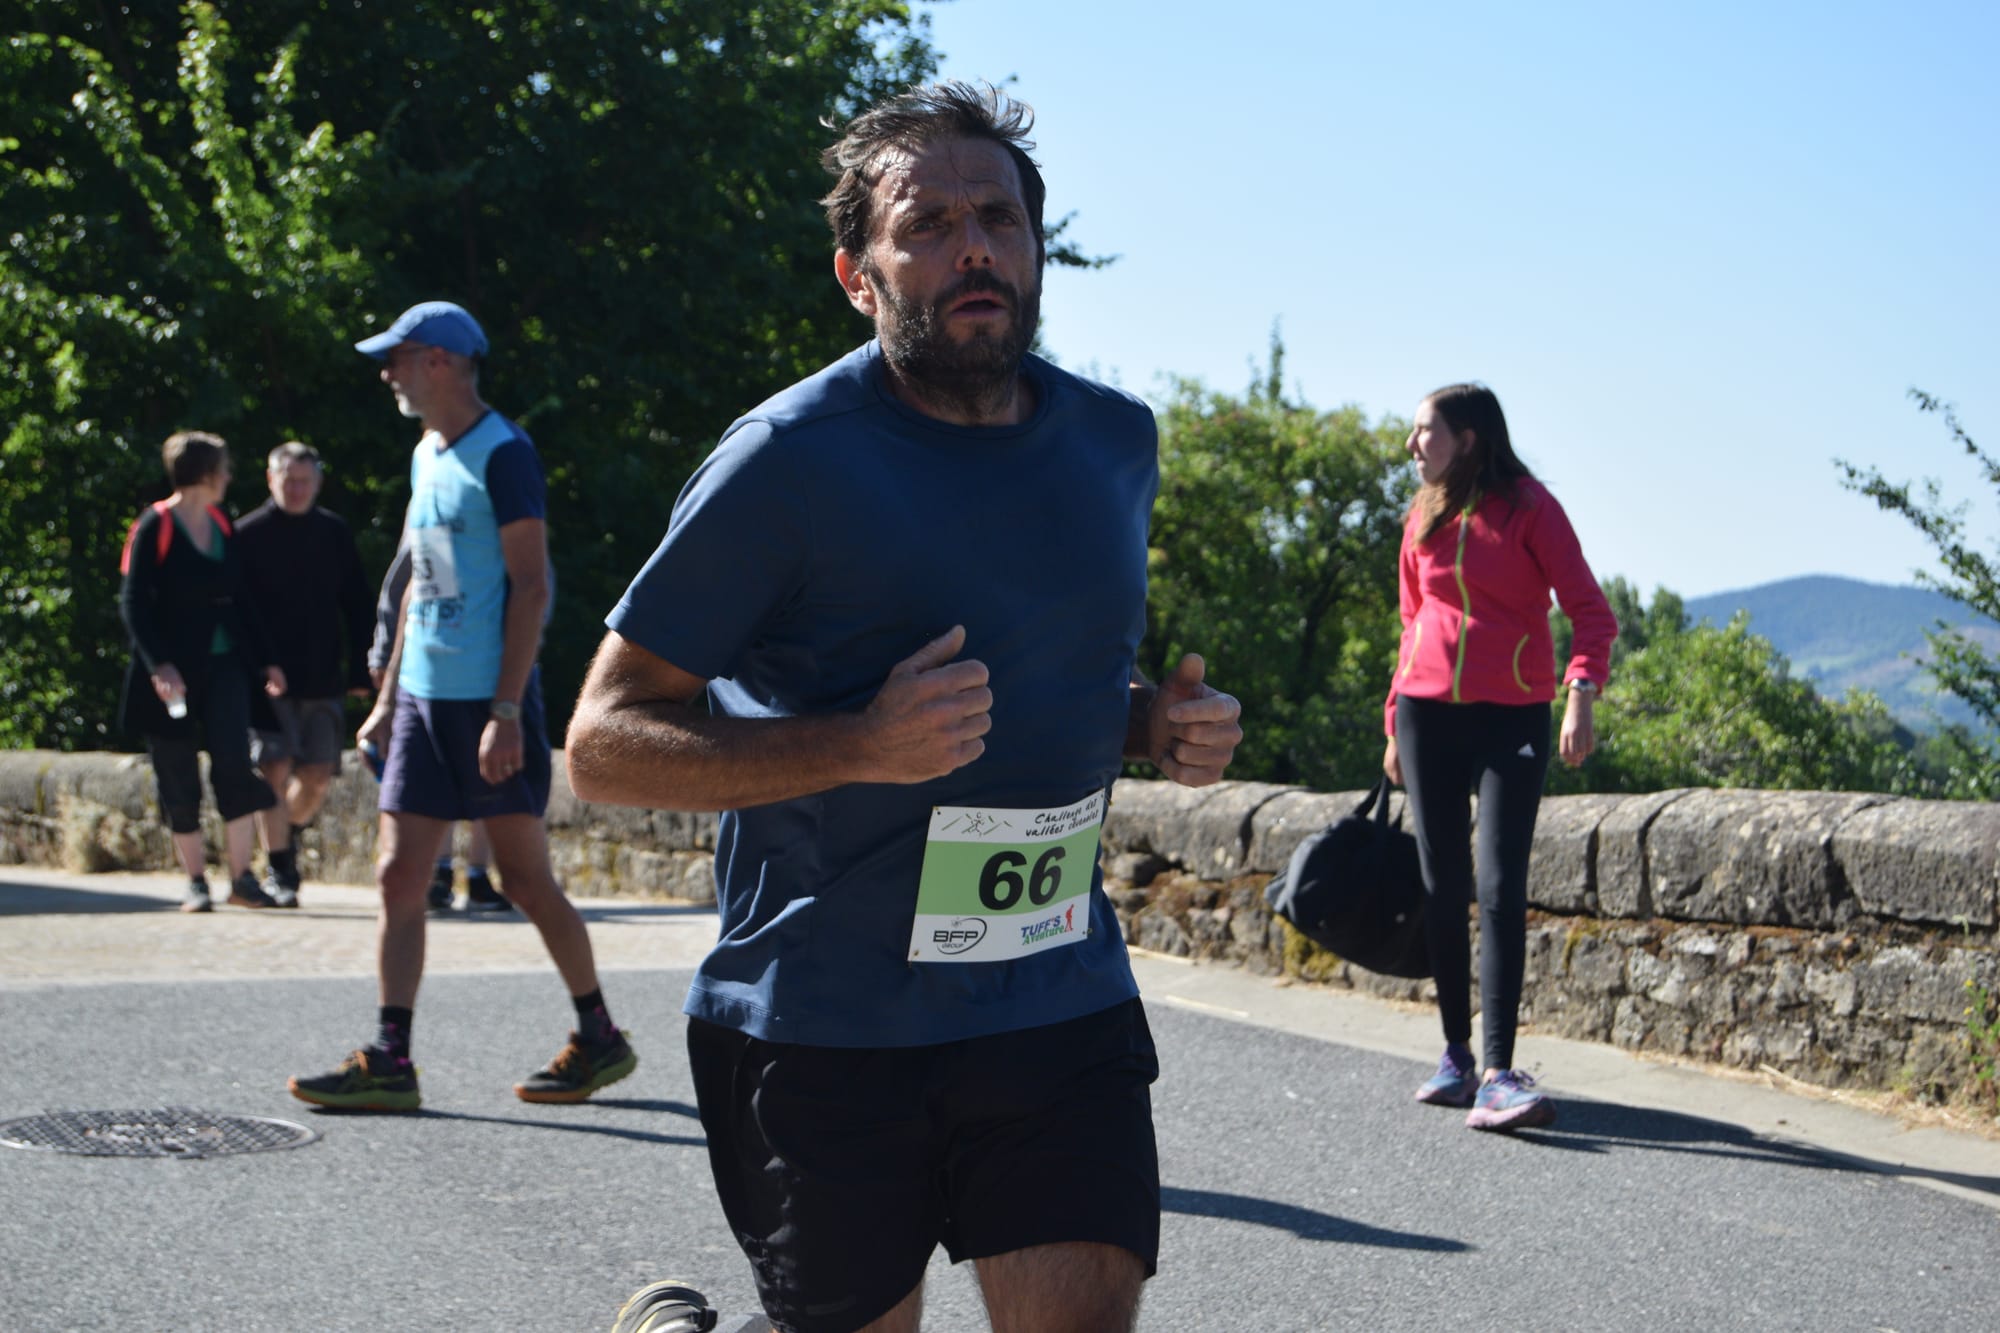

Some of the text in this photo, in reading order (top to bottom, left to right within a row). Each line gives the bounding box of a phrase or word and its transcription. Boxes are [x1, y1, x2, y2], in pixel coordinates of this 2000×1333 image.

[1034, 806, 1082, 824] Challenge
[978, 846, 1066, 911] 66
[933, 930, 979, 943] BFP
